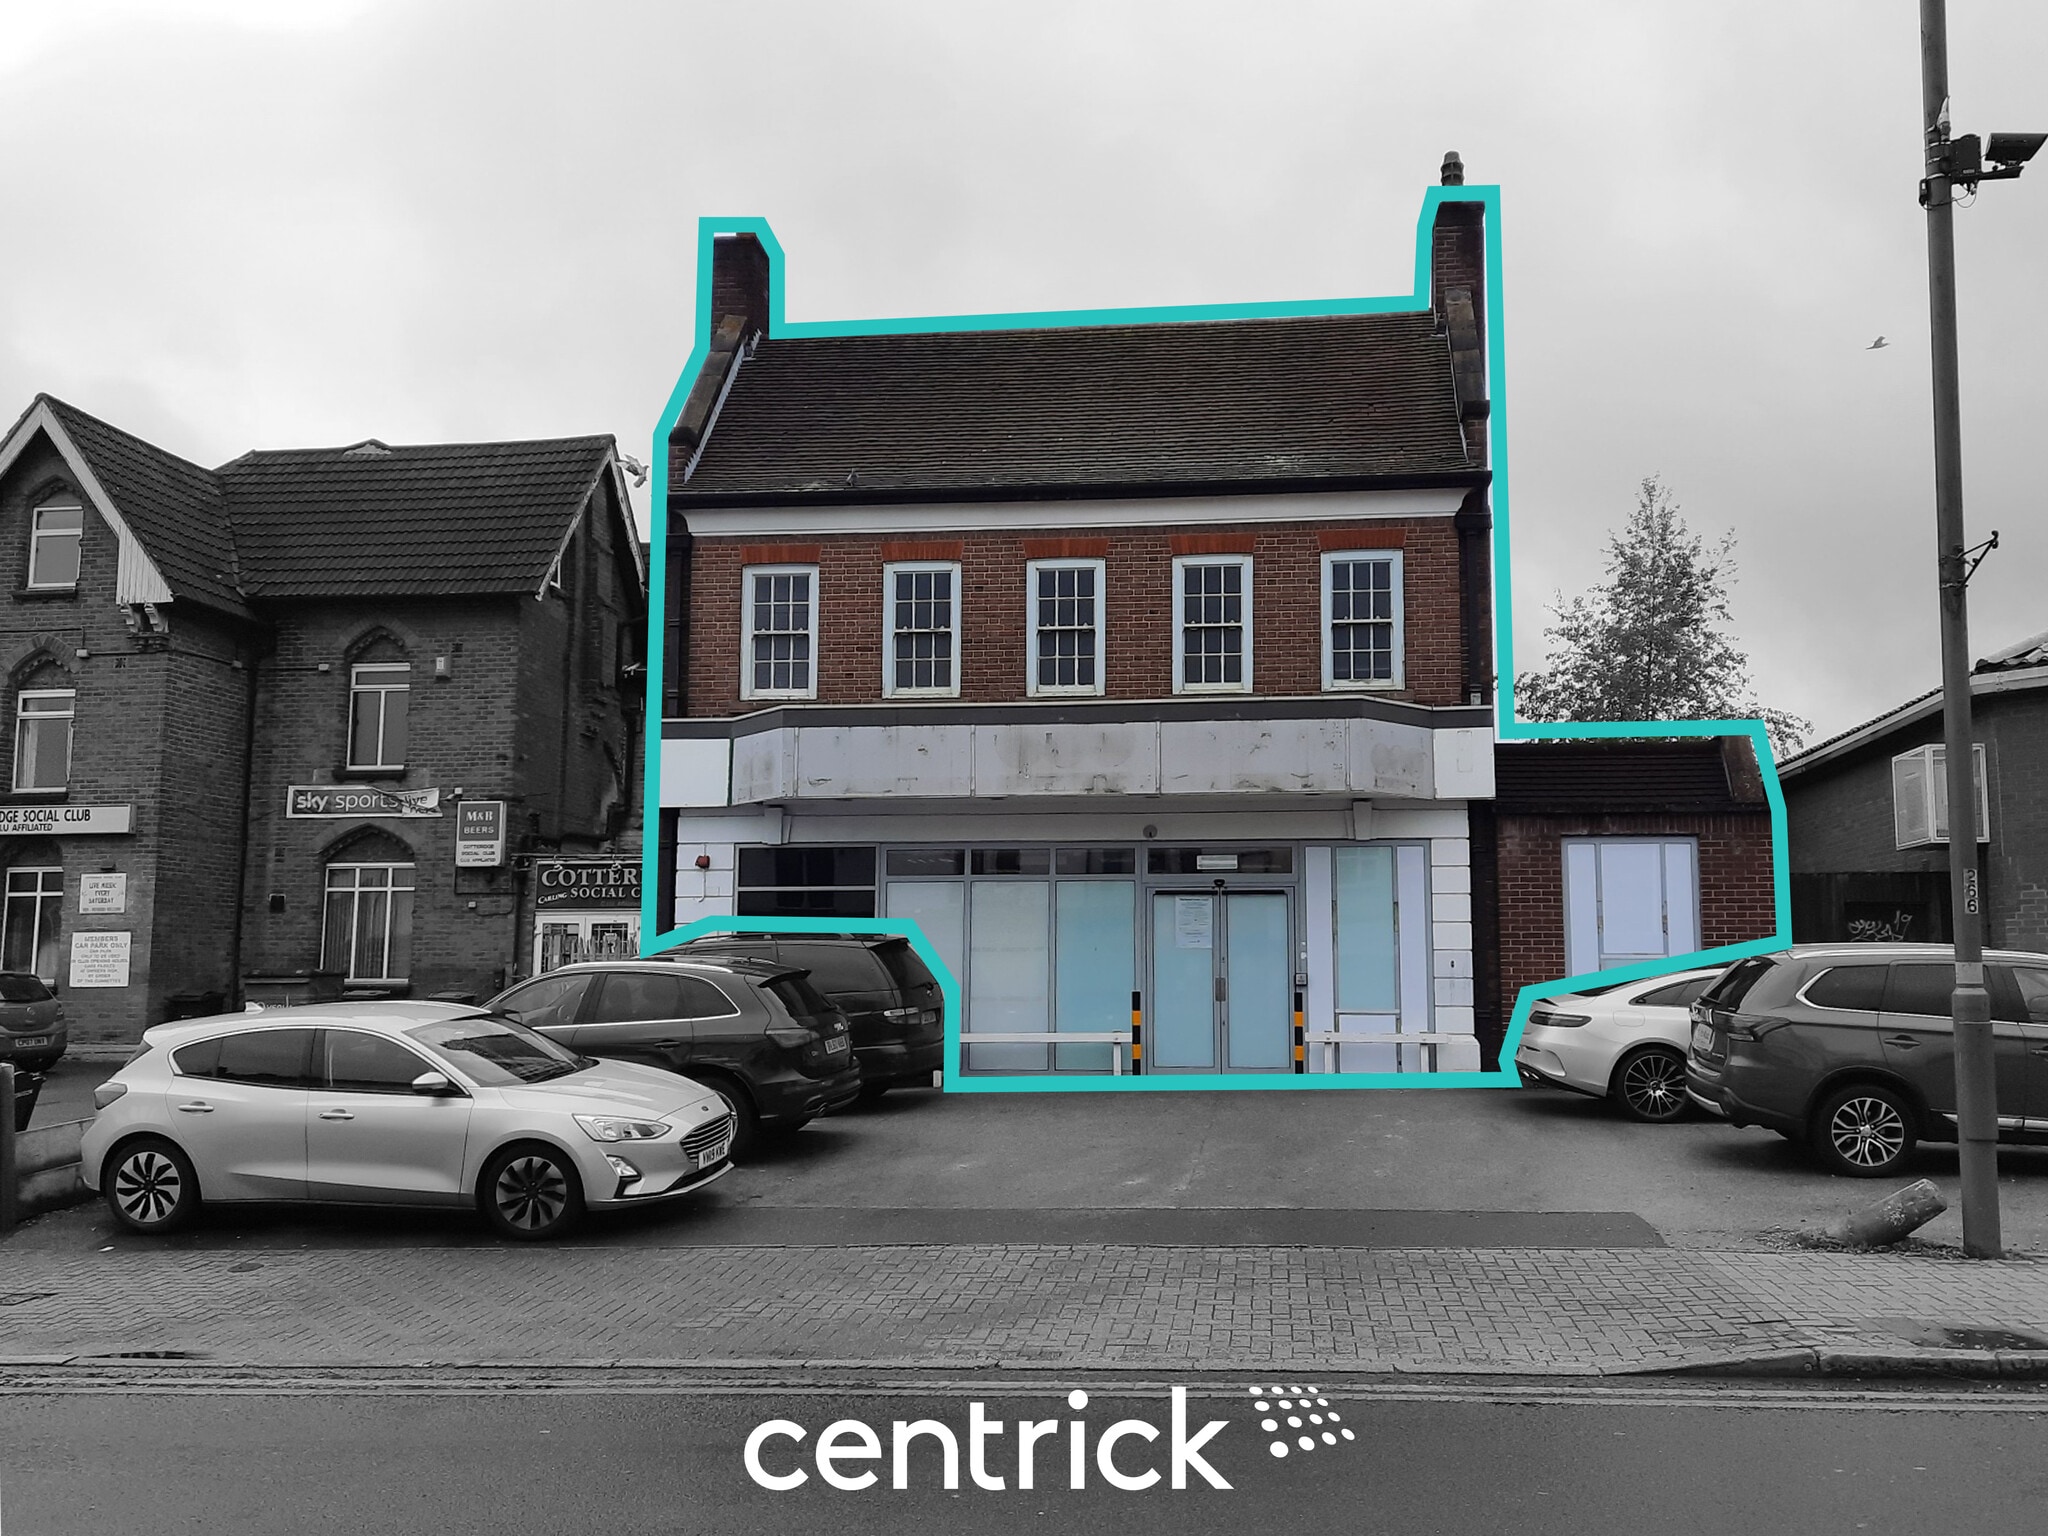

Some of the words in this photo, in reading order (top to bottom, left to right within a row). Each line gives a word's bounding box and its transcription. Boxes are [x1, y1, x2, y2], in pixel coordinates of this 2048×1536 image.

[296, 791, 328, 812] sky
[335, 793, 399, 812] sports
[23, 809, 60, 823] SOCIAL
[64, 808, 91, 822] CLUB
[466, 810, 493, 822] M&B
[12, 823, 54, 832] AFFILIATED
[463, 826, 495, 834] BEERS
[541, 868, 642, 887] COTTER
[570, 887, 626, 899] SOCIAL
